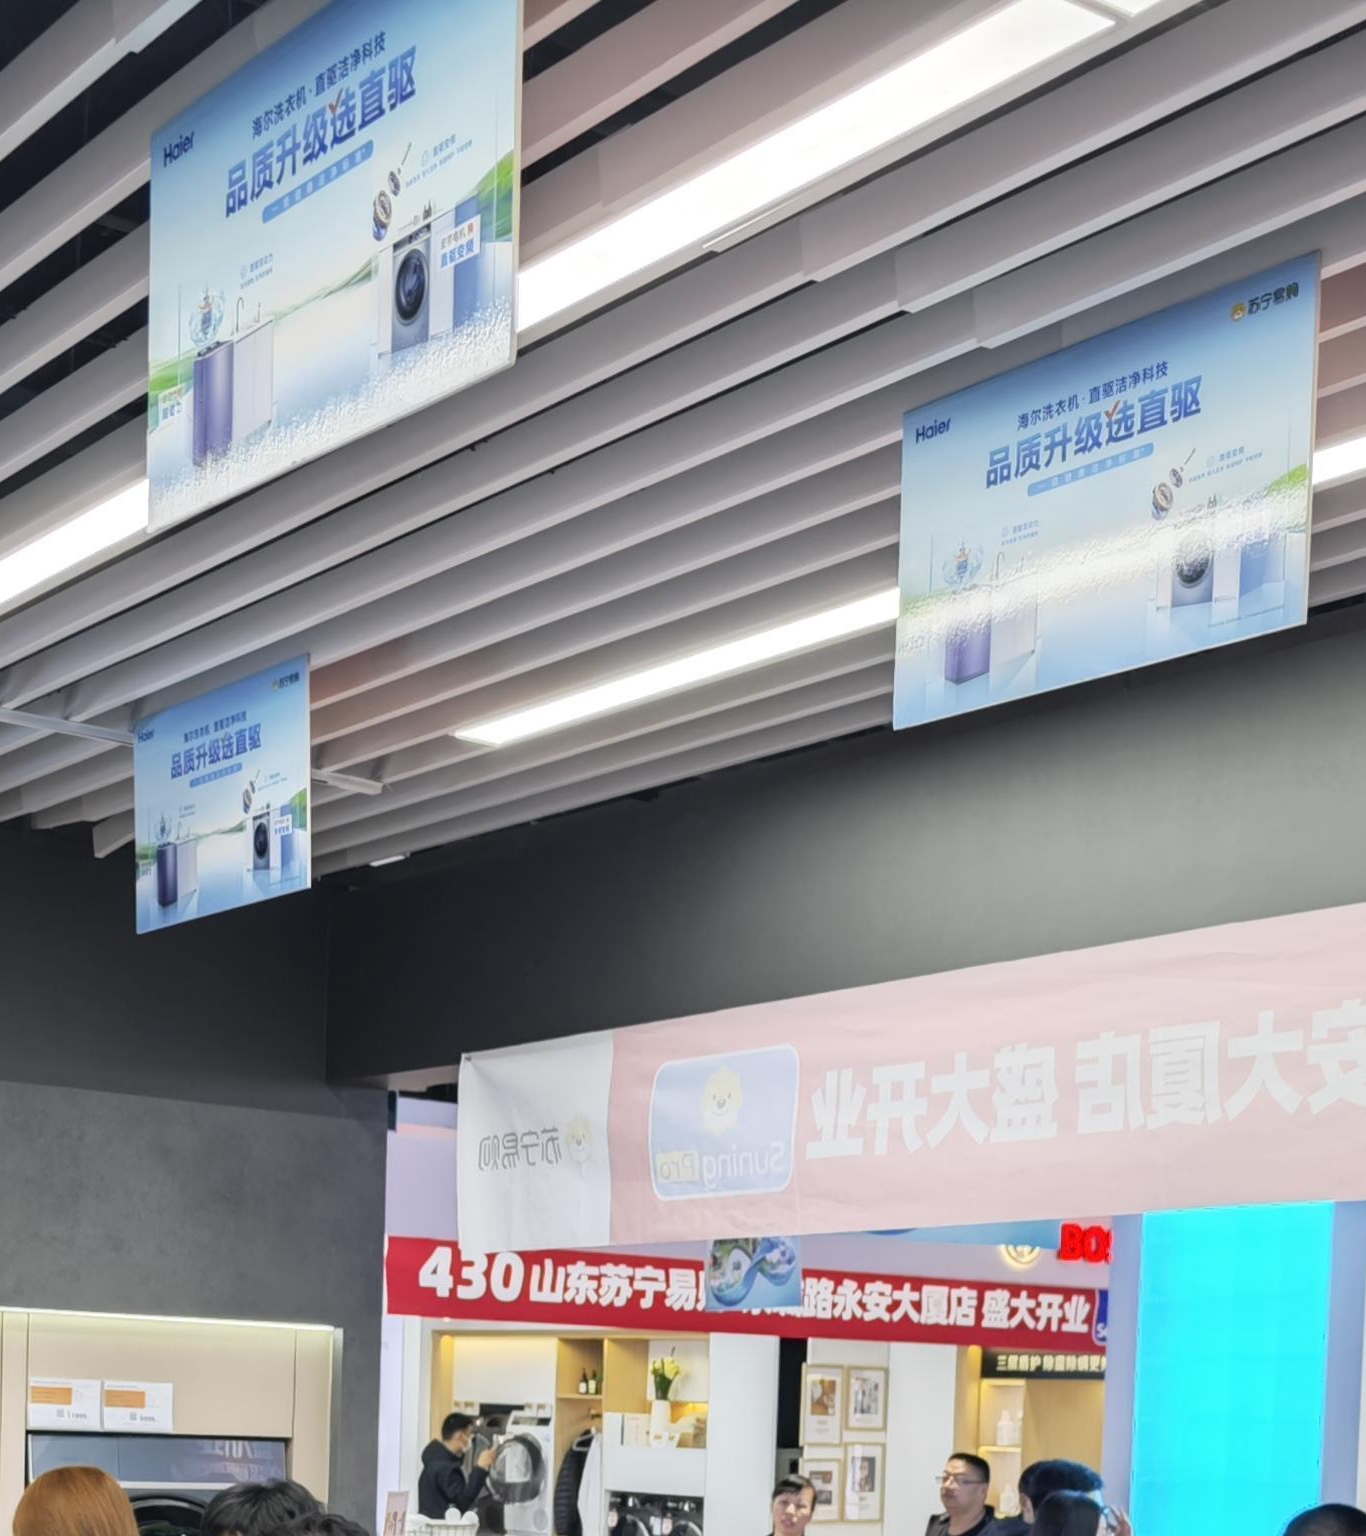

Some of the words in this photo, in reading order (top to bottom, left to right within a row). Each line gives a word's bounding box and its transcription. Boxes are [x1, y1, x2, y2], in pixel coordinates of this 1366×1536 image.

[162, 131, 195, 168] Haier
[225, 45, 417, 218] 品质升级选直驱
[915, 417, 951, 444] Haier
[984, 374, 1203, 488] 品质升级选直驱
[418, 1246, 524, 1302] 430
[529, 1258, 706, 1313] 山东苏宁易
[982, 1289, 1091, 1334] 盛大开业
